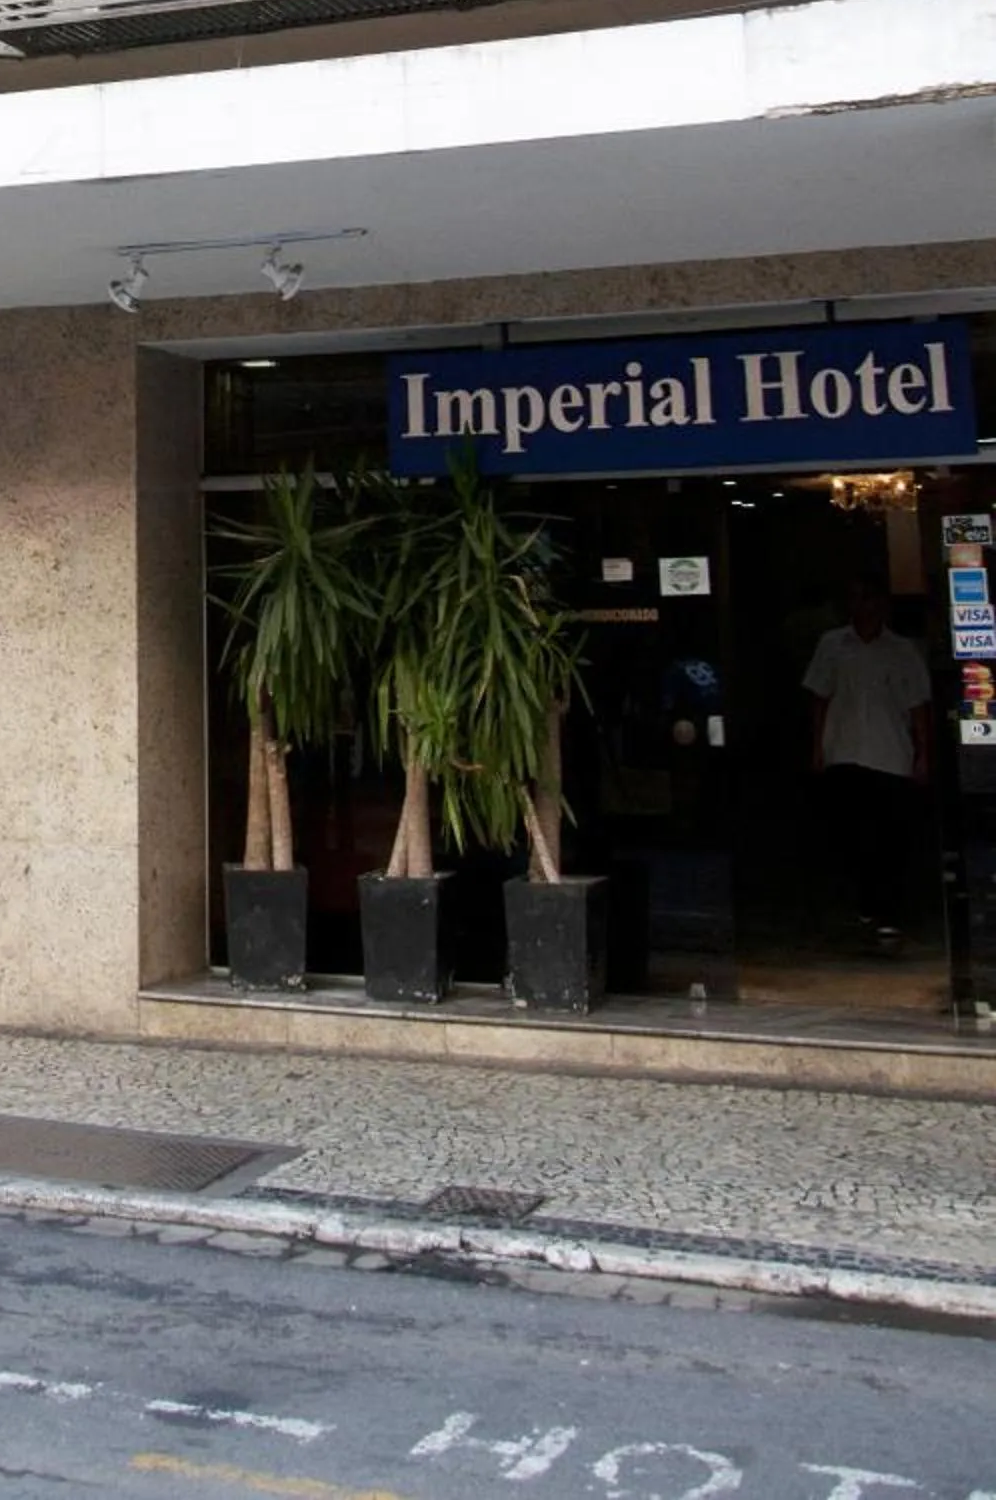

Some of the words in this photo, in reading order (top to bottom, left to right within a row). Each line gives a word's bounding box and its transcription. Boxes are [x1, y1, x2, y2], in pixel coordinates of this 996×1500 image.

[401, 357, 716, 454] Imperial
[737, 342, 954, 422] Hotel
[956, 608, 991, 622] VISA
[958, 635, 994, 649] VISA
